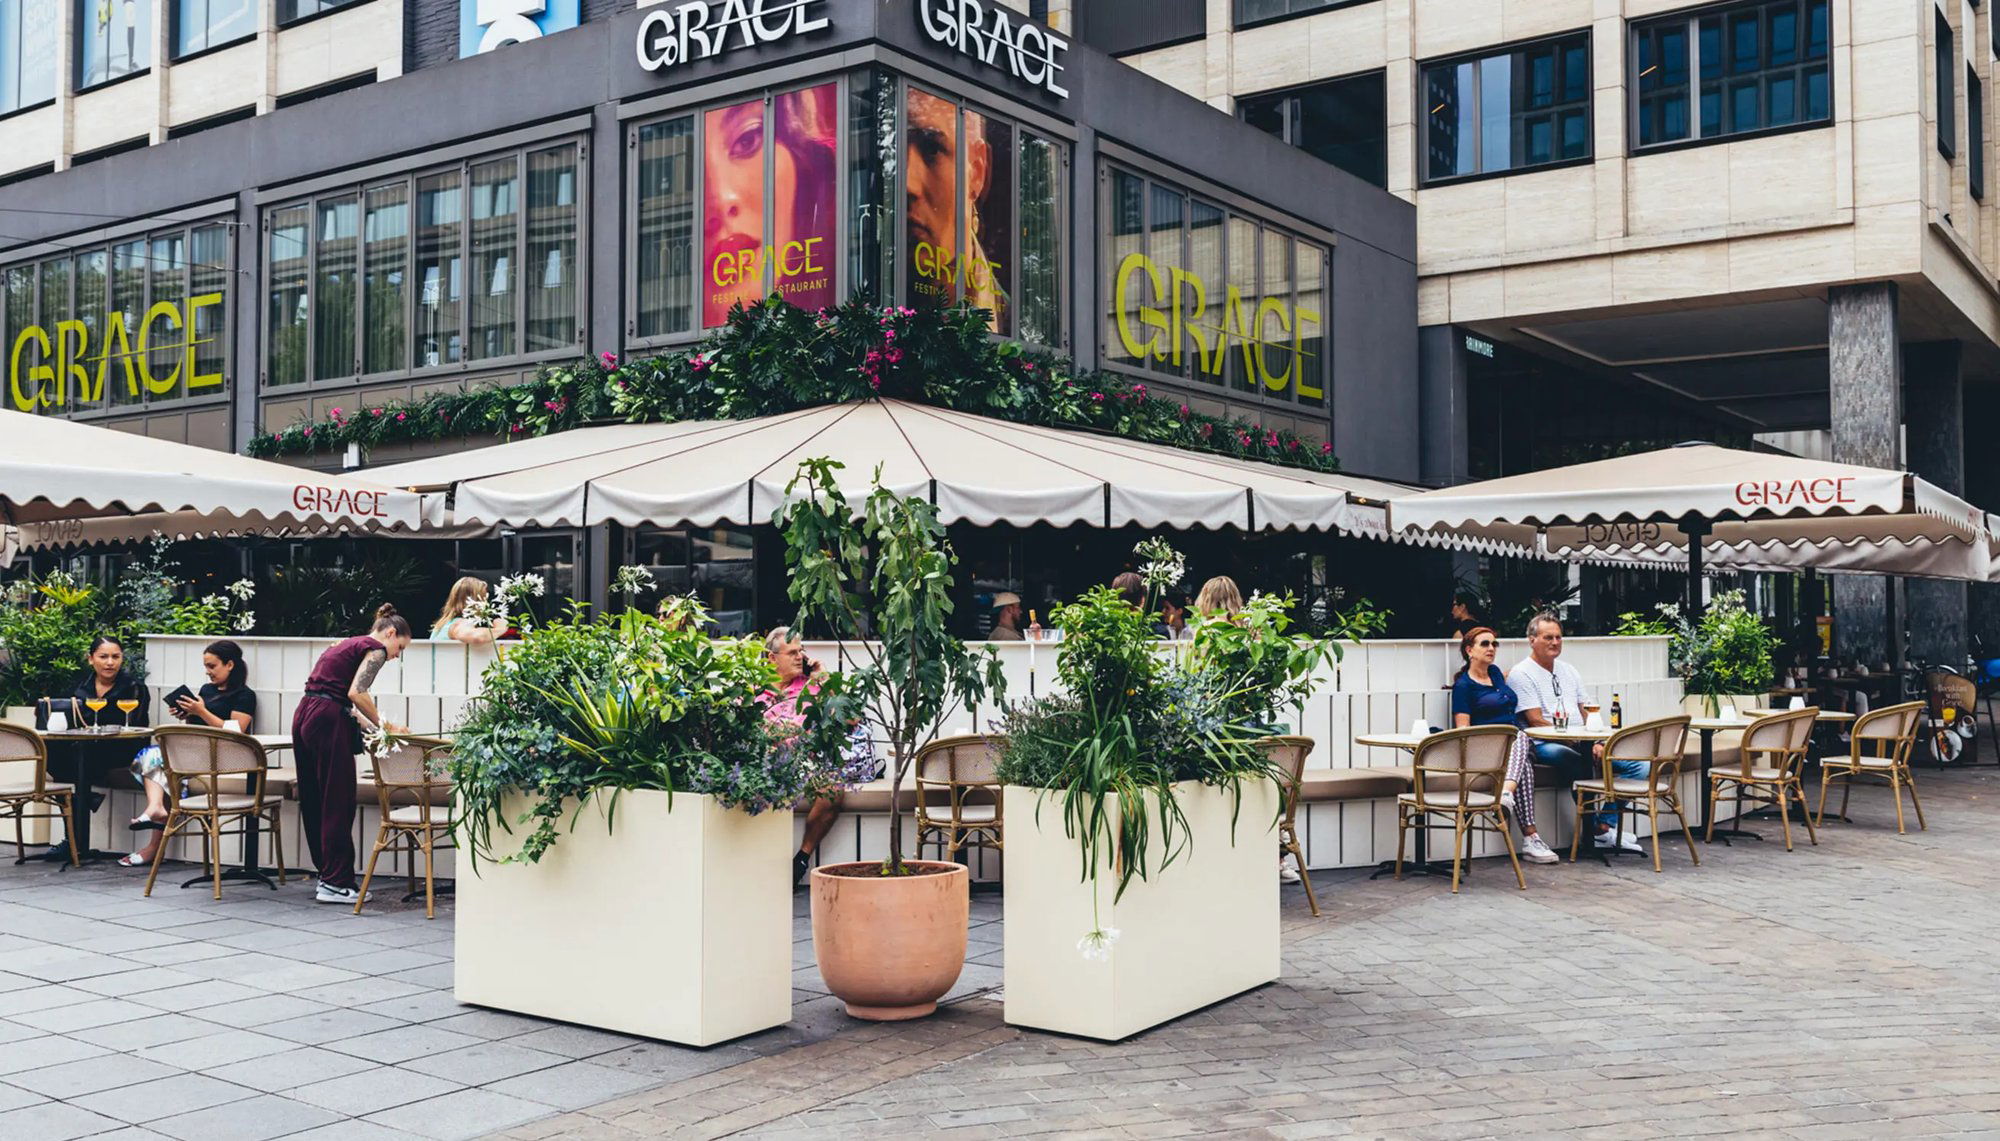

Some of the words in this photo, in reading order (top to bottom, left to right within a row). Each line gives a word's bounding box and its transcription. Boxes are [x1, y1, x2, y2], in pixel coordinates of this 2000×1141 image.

[636, 0, 829, 72] GRACE
[920, 0, 1070, 99] GRACE
[713, 237, 824, 287] GRACE
[914, 241, 1002, 296] GRACE
[9, 292, 224, 413] GRACE
[1115, 253, 1323, 399] GRACE
[292, 484, 388, 517] GRACE
[1736, 477, 1857, 506] GRACE
